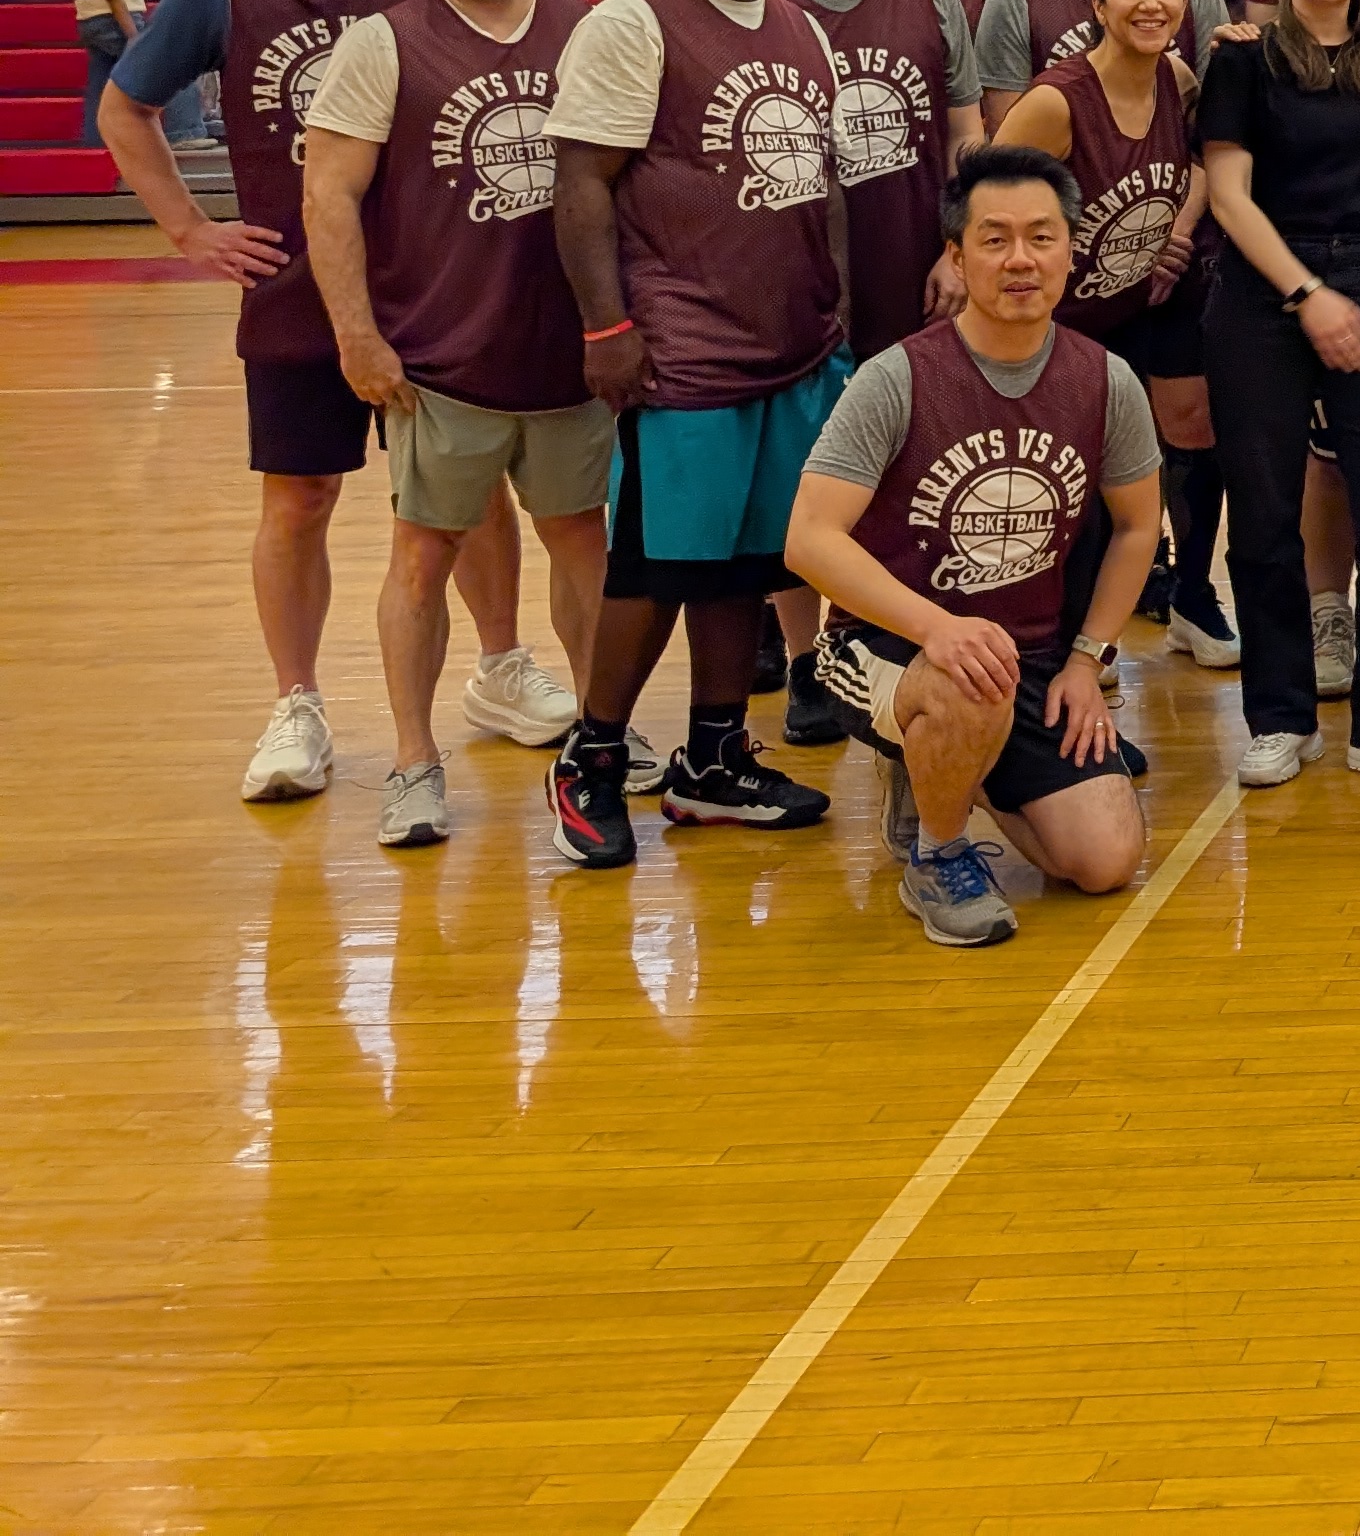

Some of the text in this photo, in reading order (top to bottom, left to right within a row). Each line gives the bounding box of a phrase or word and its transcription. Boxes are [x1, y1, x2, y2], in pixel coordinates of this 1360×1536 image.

[252, 18, 332, 112] PARENTS
[857, 47, 889, 73] VS
[890, 56, 932, 122] STAFF
[432, 69, 550, 168] PARENTS VS
[702, 61, 771, 153] PARENTS
[771, 62, 800, 93] VS
[843, 112, 909, 135] KETBALL
[472, 140, 557, 166] BASKETBA
[742, 134, 822, 154] BASKETBALL
[836, 147, 919, 178] onnors
[468, 185, 554, 223] Conn
[1072, 169, 1146, 256] PARENTS
[1149, 162, 1175, 190] VS
[909, 428, 1088, 529] PARENTS VS STAFF
[950, 511, 1056, 534] BASKETBALL
[930, 550, 1059, 592] Connors
